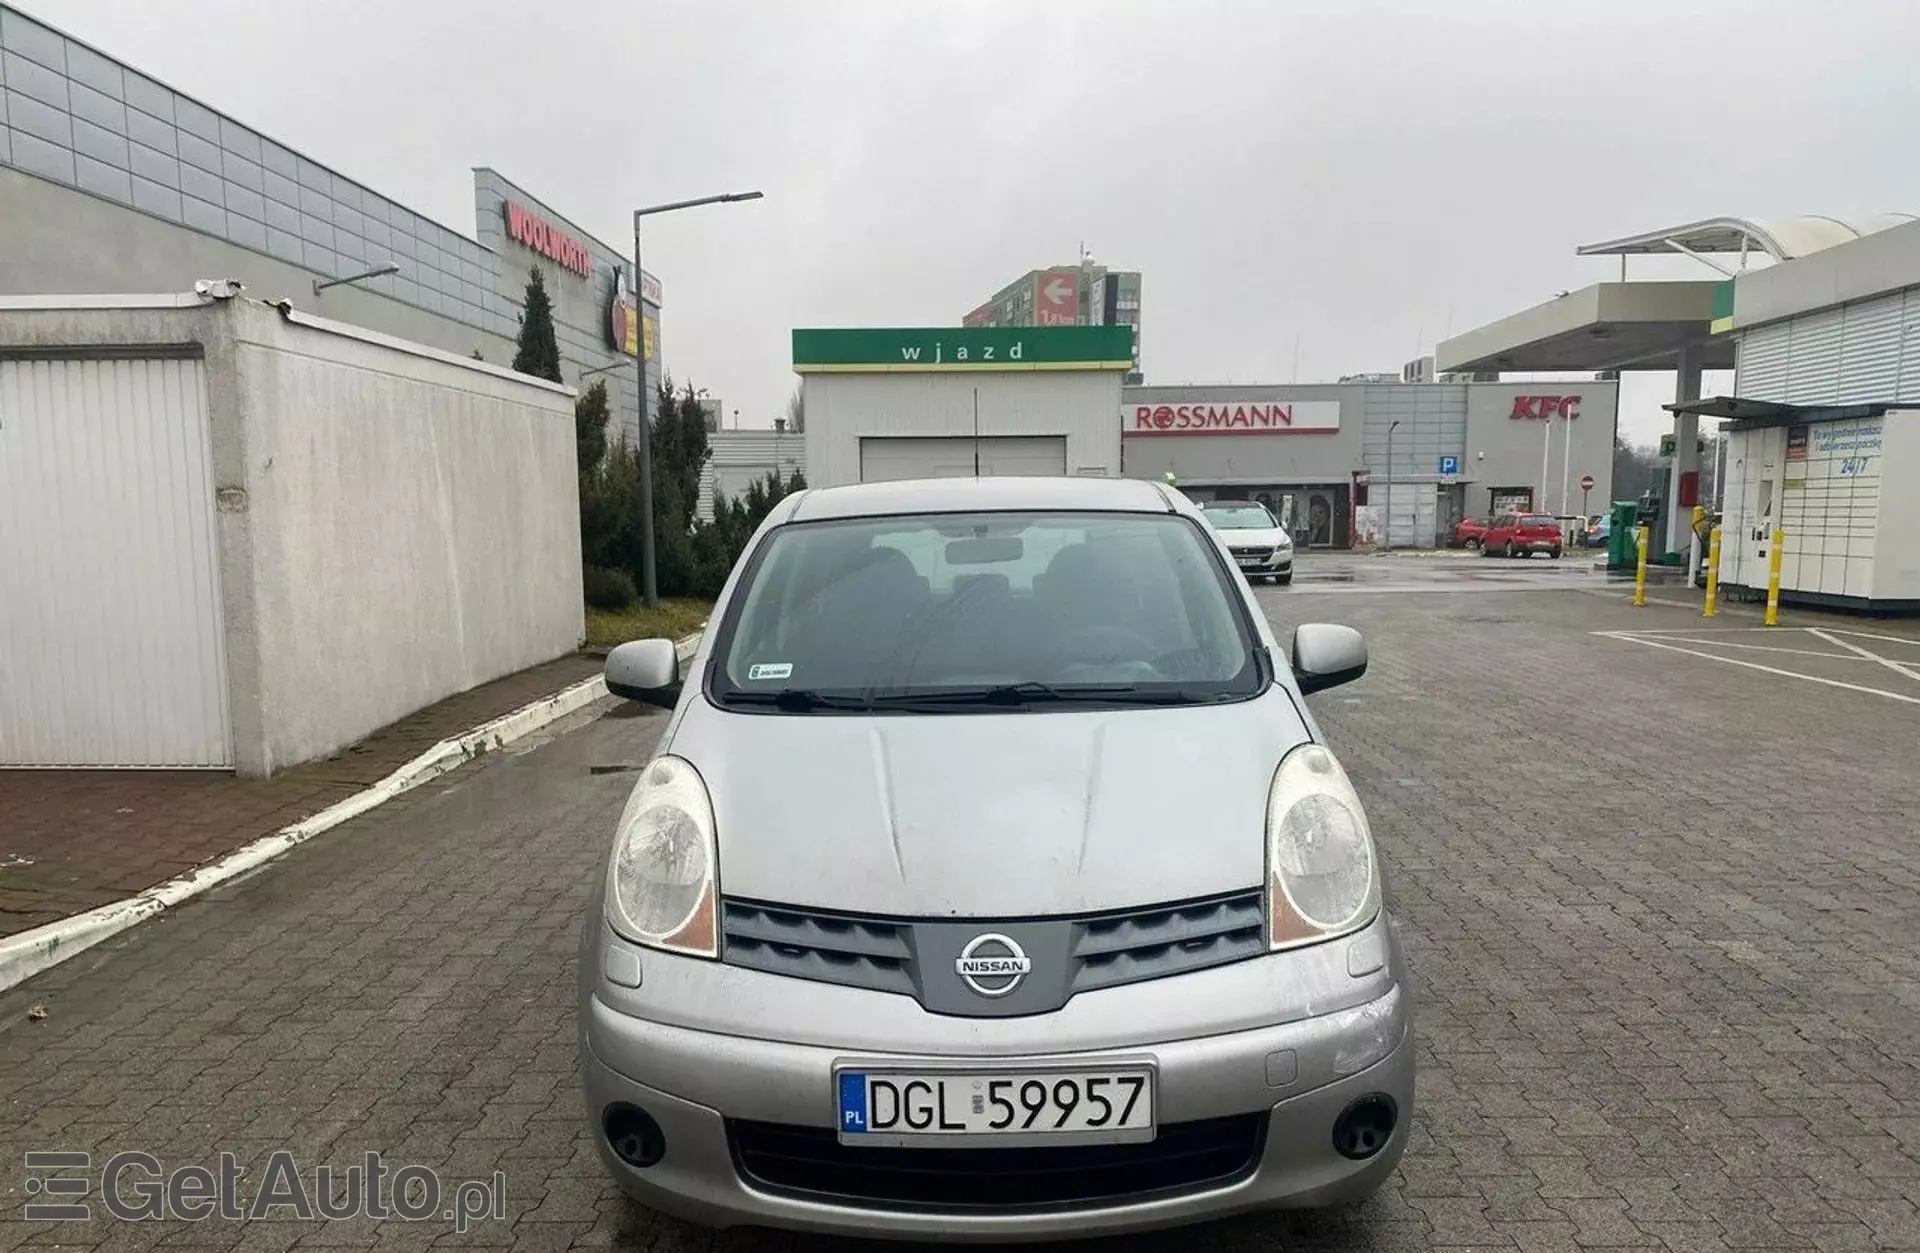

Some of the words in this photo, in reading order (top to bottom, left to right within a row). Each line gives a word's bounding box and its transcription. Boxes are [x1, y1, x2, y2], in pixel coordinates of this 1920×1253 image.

[902, 341, 1023, 363] wjazd
[1136, 404, 1293, 429] ROSSMANN
[1509, 395, 1582, 420] KFC
[1443, 458, 1454, 472] P
[962, 960, 1024, 973] NISSAN
[870, 1080, 966, 1130] DGL
[988, 1076, 1145, 1129] 59957
[845, 1111, 864, 1125] PL
